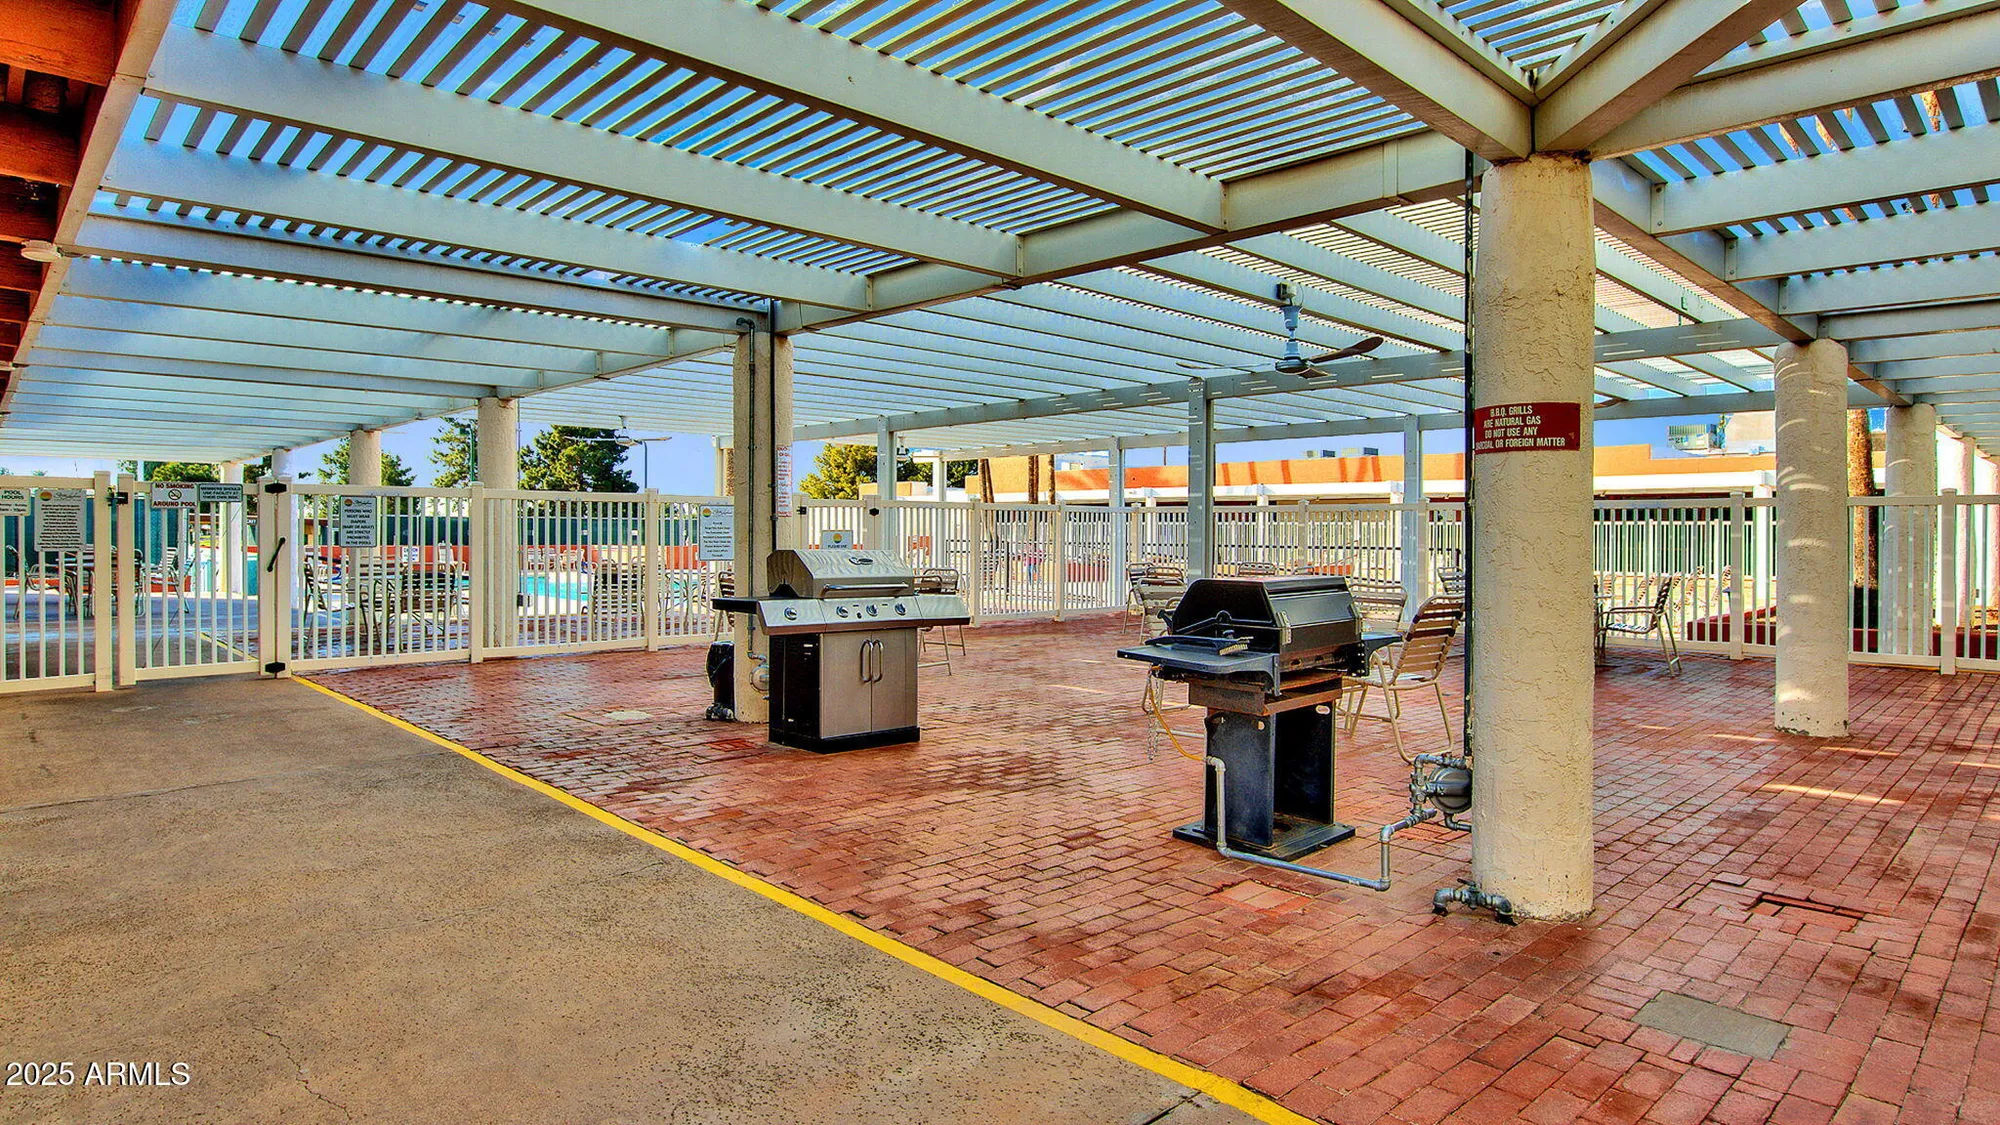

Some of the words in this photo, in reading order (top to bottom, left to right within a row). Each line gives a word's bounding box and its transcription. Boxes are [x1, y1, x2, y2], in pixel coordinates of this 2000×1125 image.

[1490, 407, 1507, 417] B.B.Q.
[1508, 405, 1533, 415] GRILLS
[1483, 419, 1494, 428] ARE
[1494, 417, 1524, 427] NATURAL
[1526, 415, 1541, 425] GAS
[1485, 430, 1492, 439] DO
[1493, 428, 1506, 438] NOT
[1507, 427, 1521, 437] USE
[1523, 426, 1538, 436] ANY
[1495, 439, 1504, 448] OR
[1505, 437, 1534, 448] FOREIGN
[1536, 437, 1566, 447] MATTER
